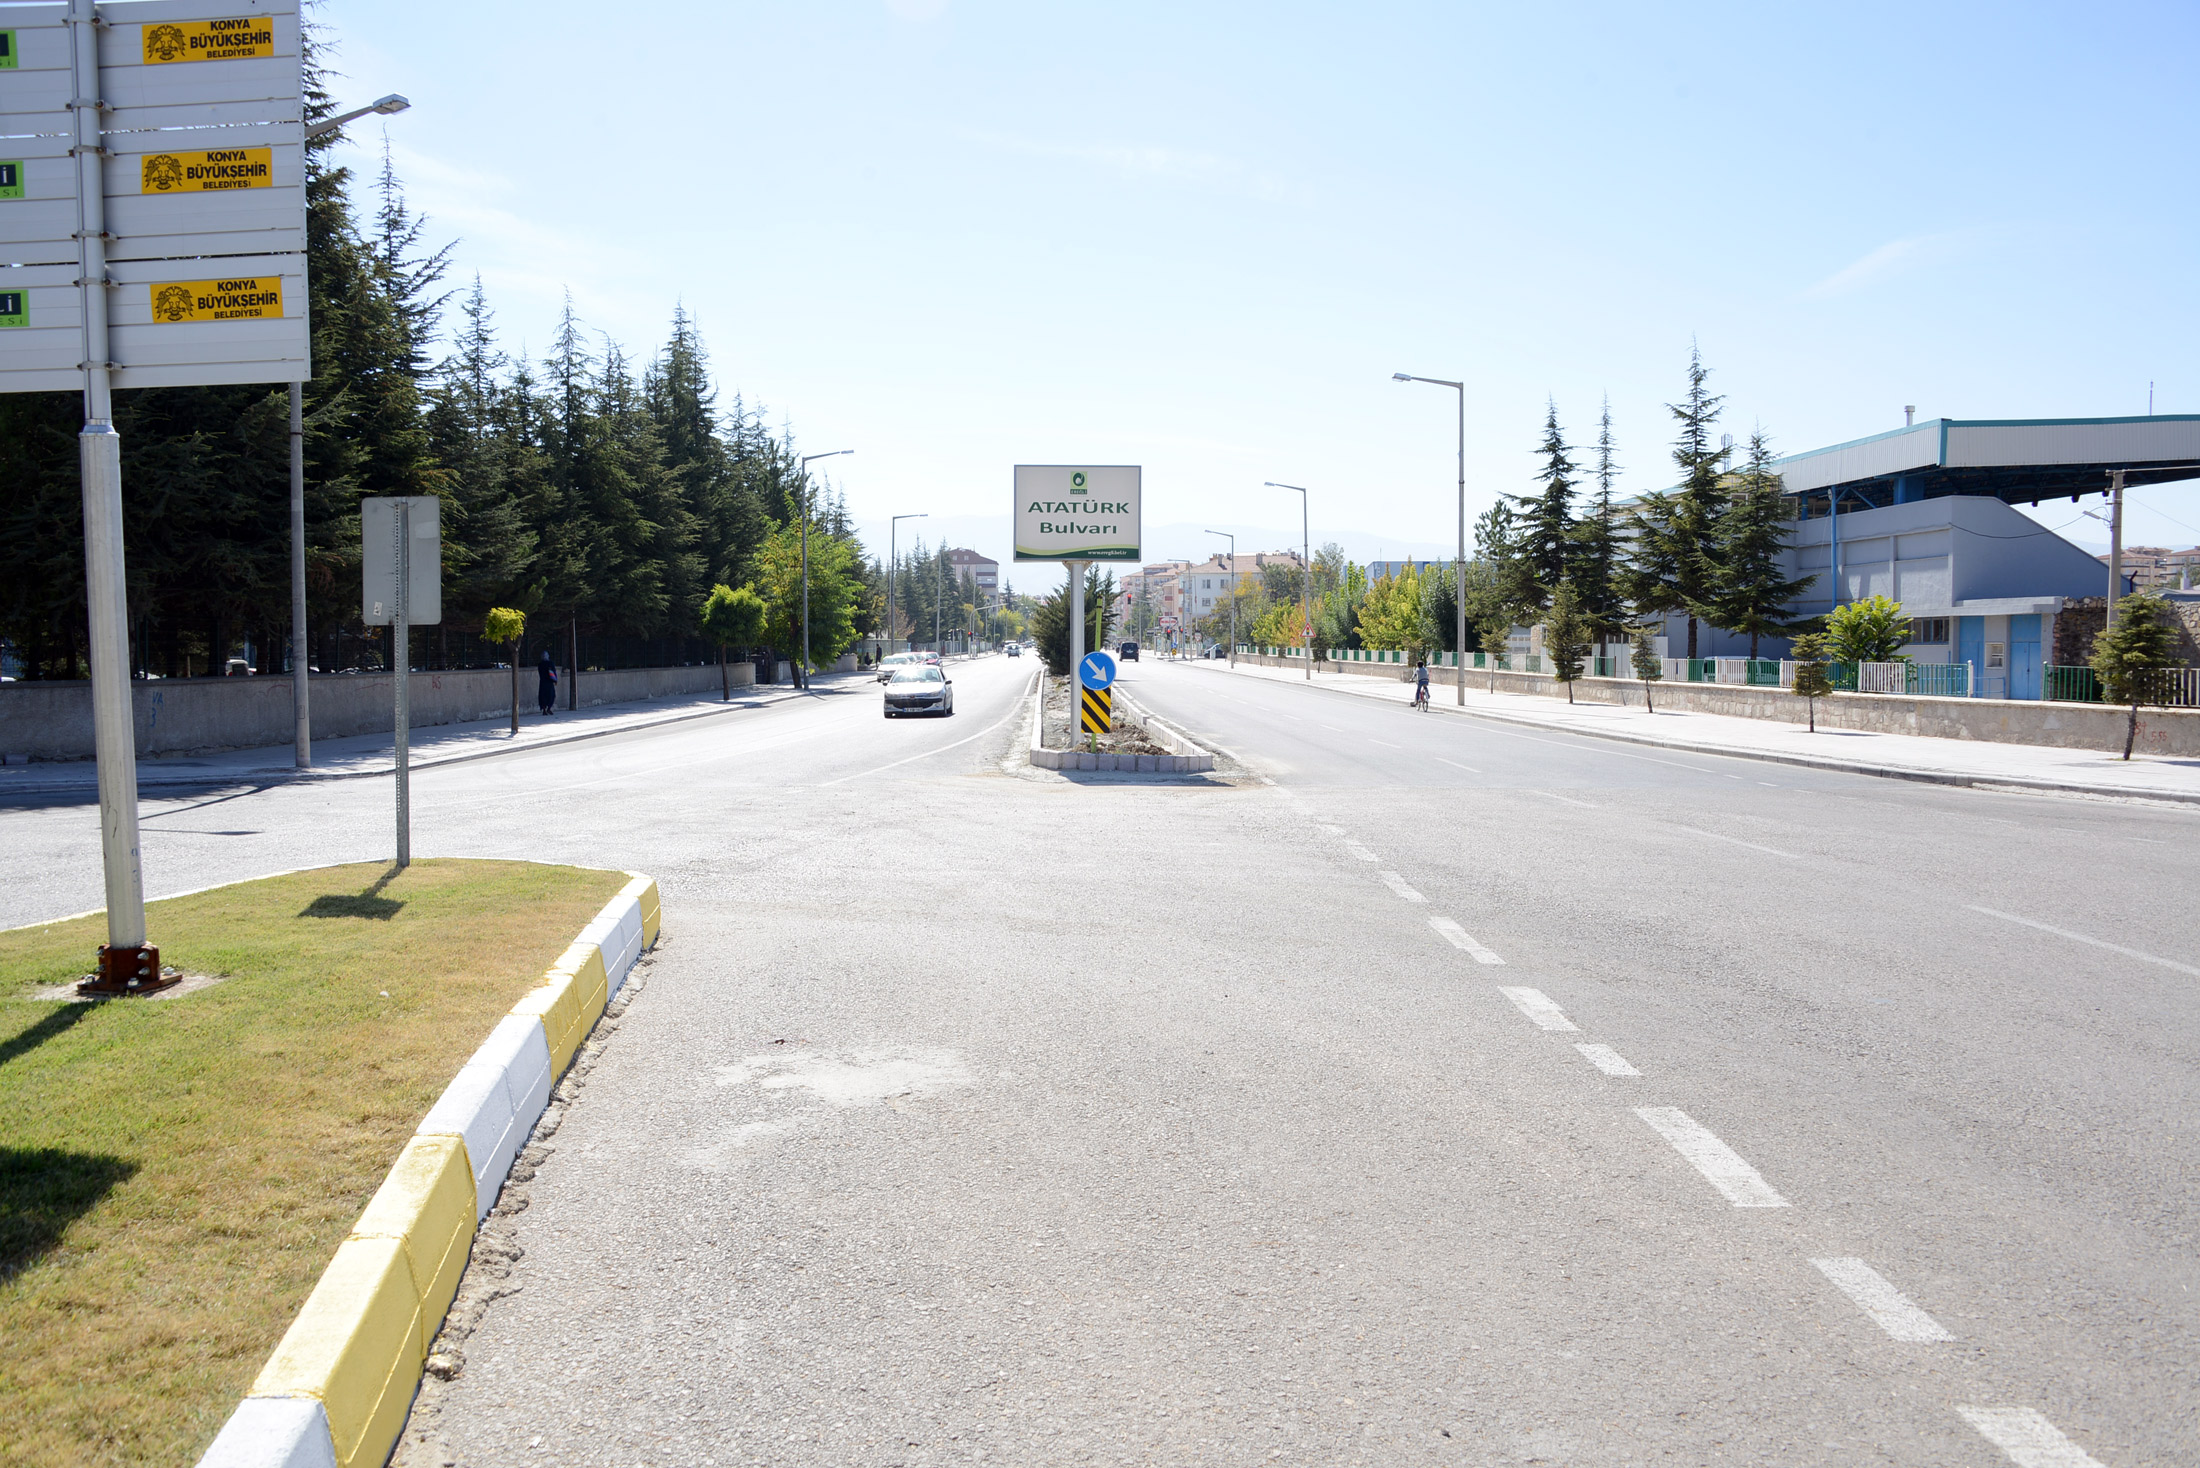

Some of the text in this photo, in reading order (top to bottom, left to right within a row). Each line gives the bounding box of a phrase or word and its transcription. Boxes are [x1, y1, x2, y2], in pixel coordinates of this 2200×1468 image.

[210, 19, 250, 31] KONYA
[190, 29, 271, 49] BÜYÜKŞEHİR
[206, 46, 255, 58] BELEDİYESİ
[207, 151, 247, 162] KONYA
[187, 161, 267, 179] BÜYÜKŞEHİR
[202, 178, 252, 189] BELEDİYESİ
[217, 280, 257, 292] KONYA
[197, 290, 278, 309] BÜYÜKŞEHİR
[214, 307, 262, 319] BELEDİYESİ
[1028, 499, 1129, 514] ATATÜRK
[1040, 522, 1117, 534] Bulvarı
